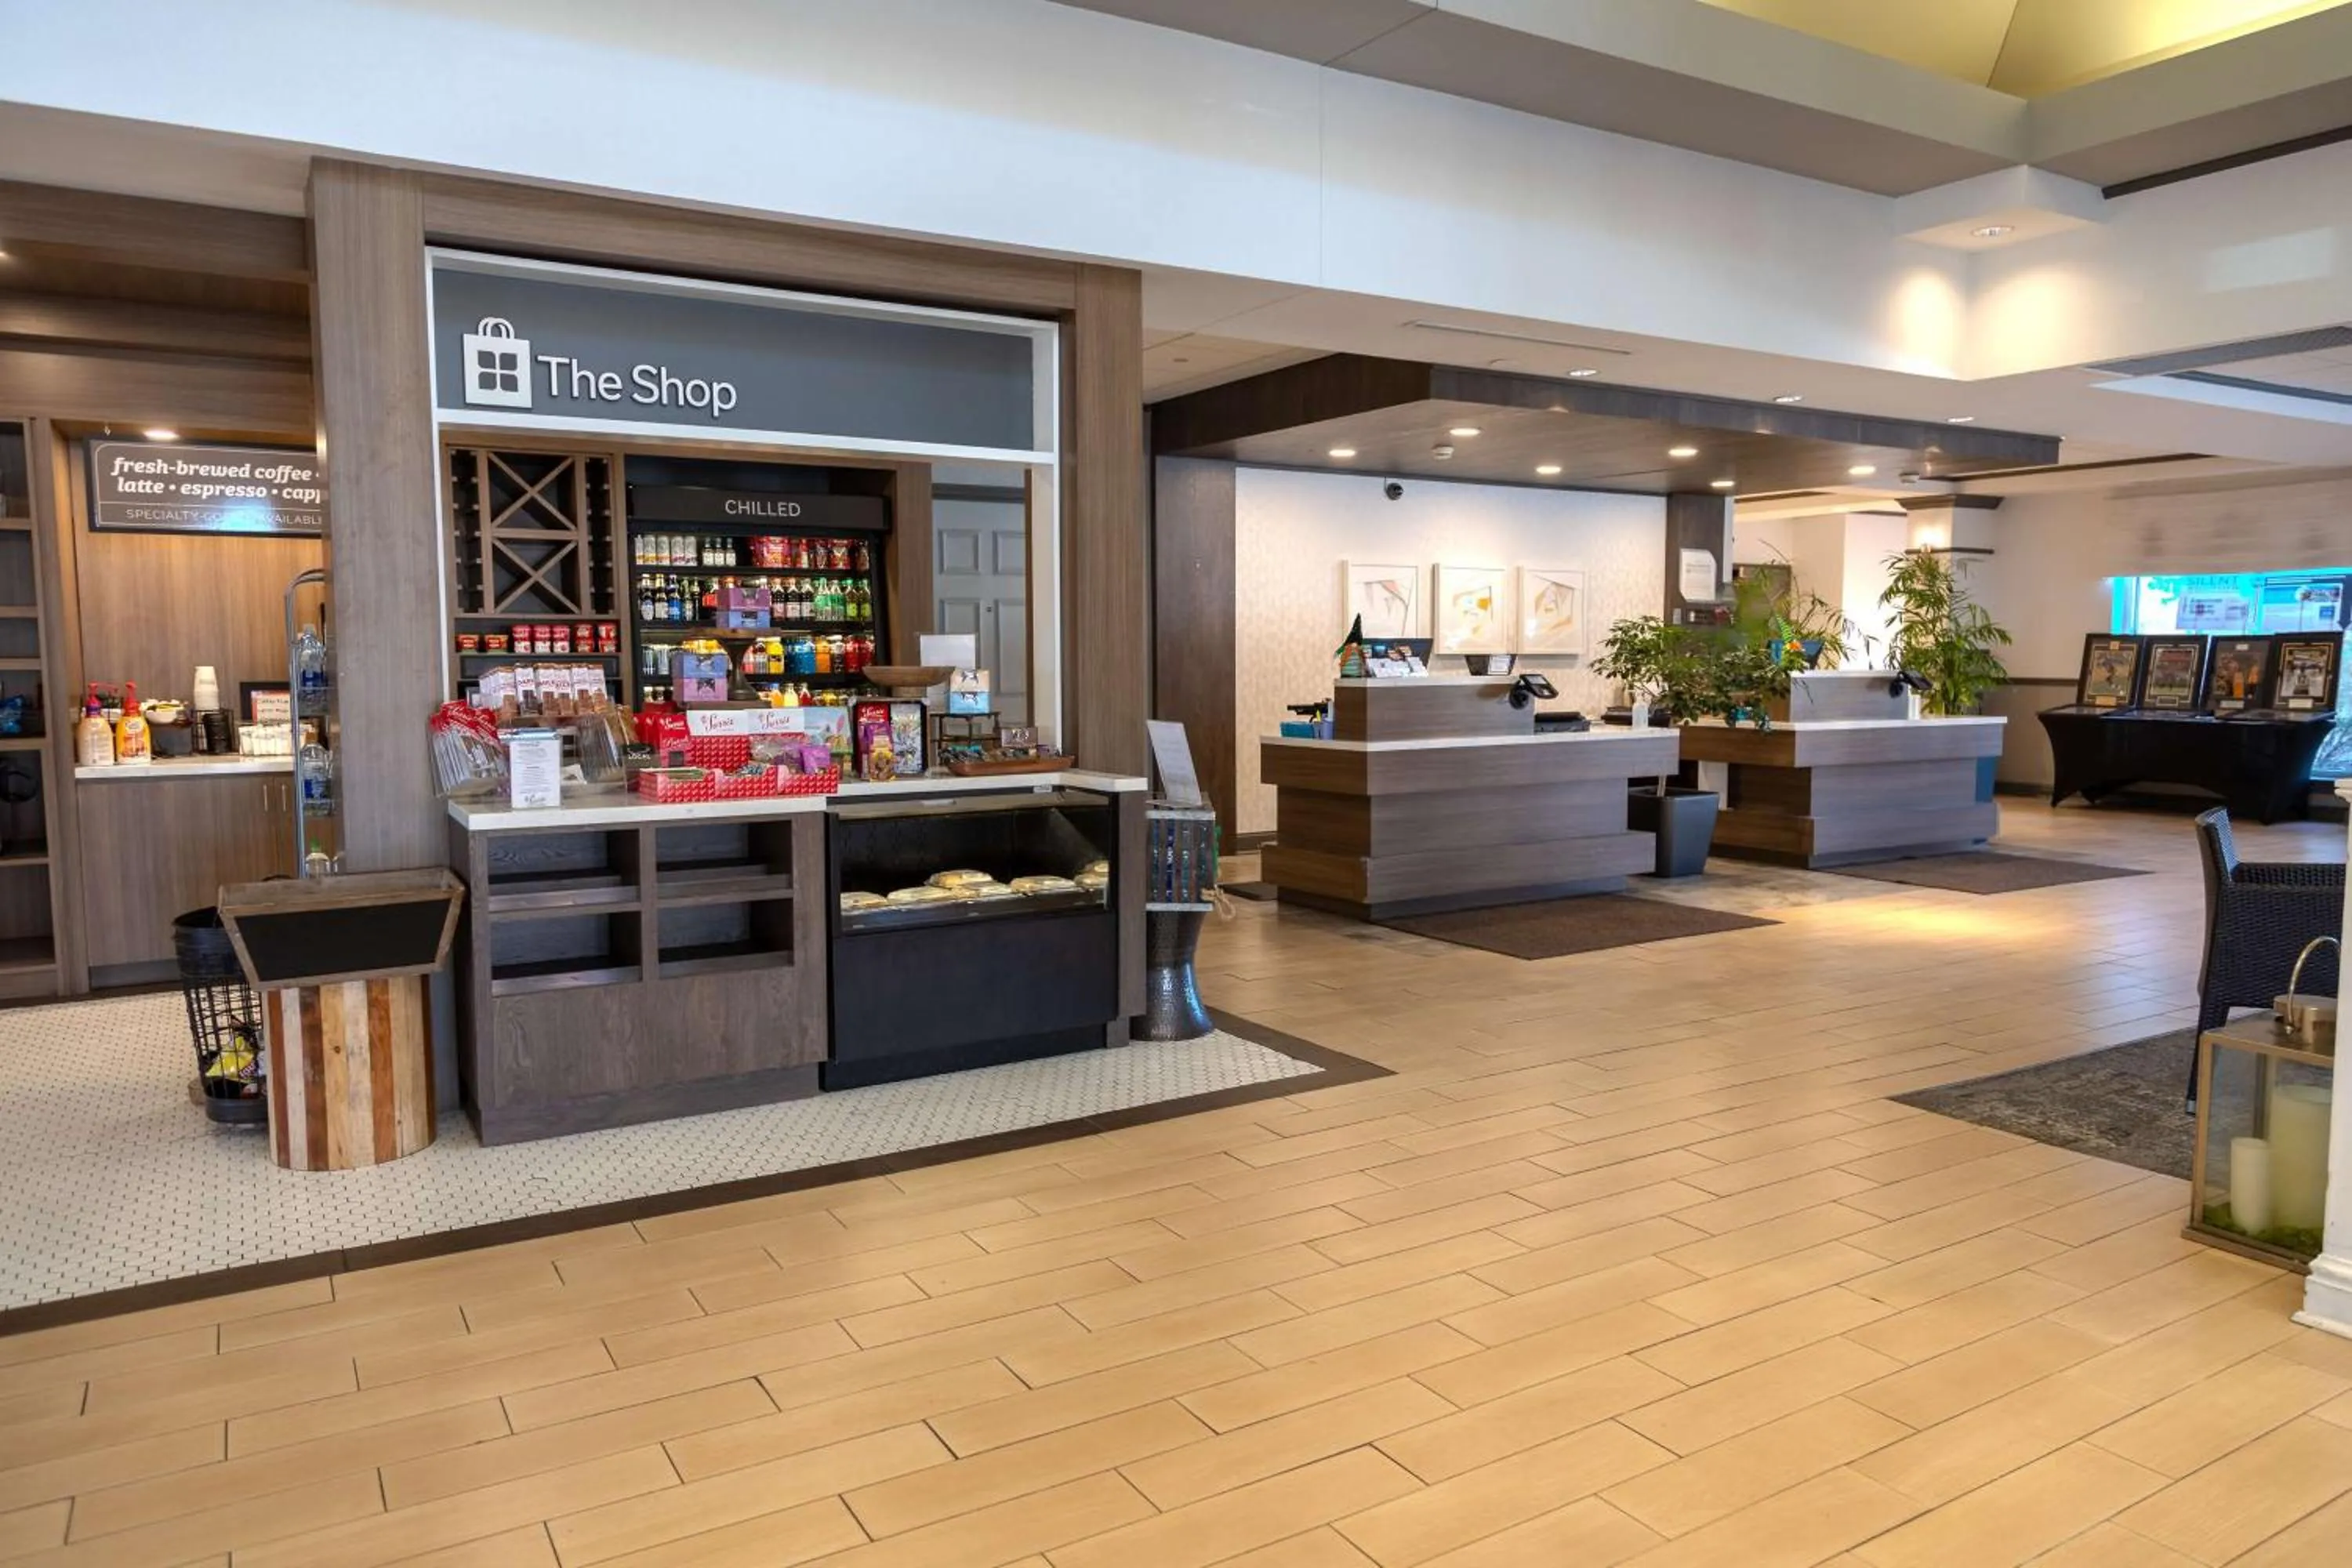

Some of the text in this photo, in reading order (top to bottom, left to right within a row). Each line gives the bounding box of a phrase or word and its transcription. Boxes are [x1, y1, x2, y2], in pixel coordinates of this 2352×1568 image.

[536, 354, 738, 416] The Shop
[111, 457, 312, 484] fresh-brewed coffee
[117, 477, 164, 494] latte
[180, 484, 267, 499] espresso
[724, 499, 801, 517] CHILLED
